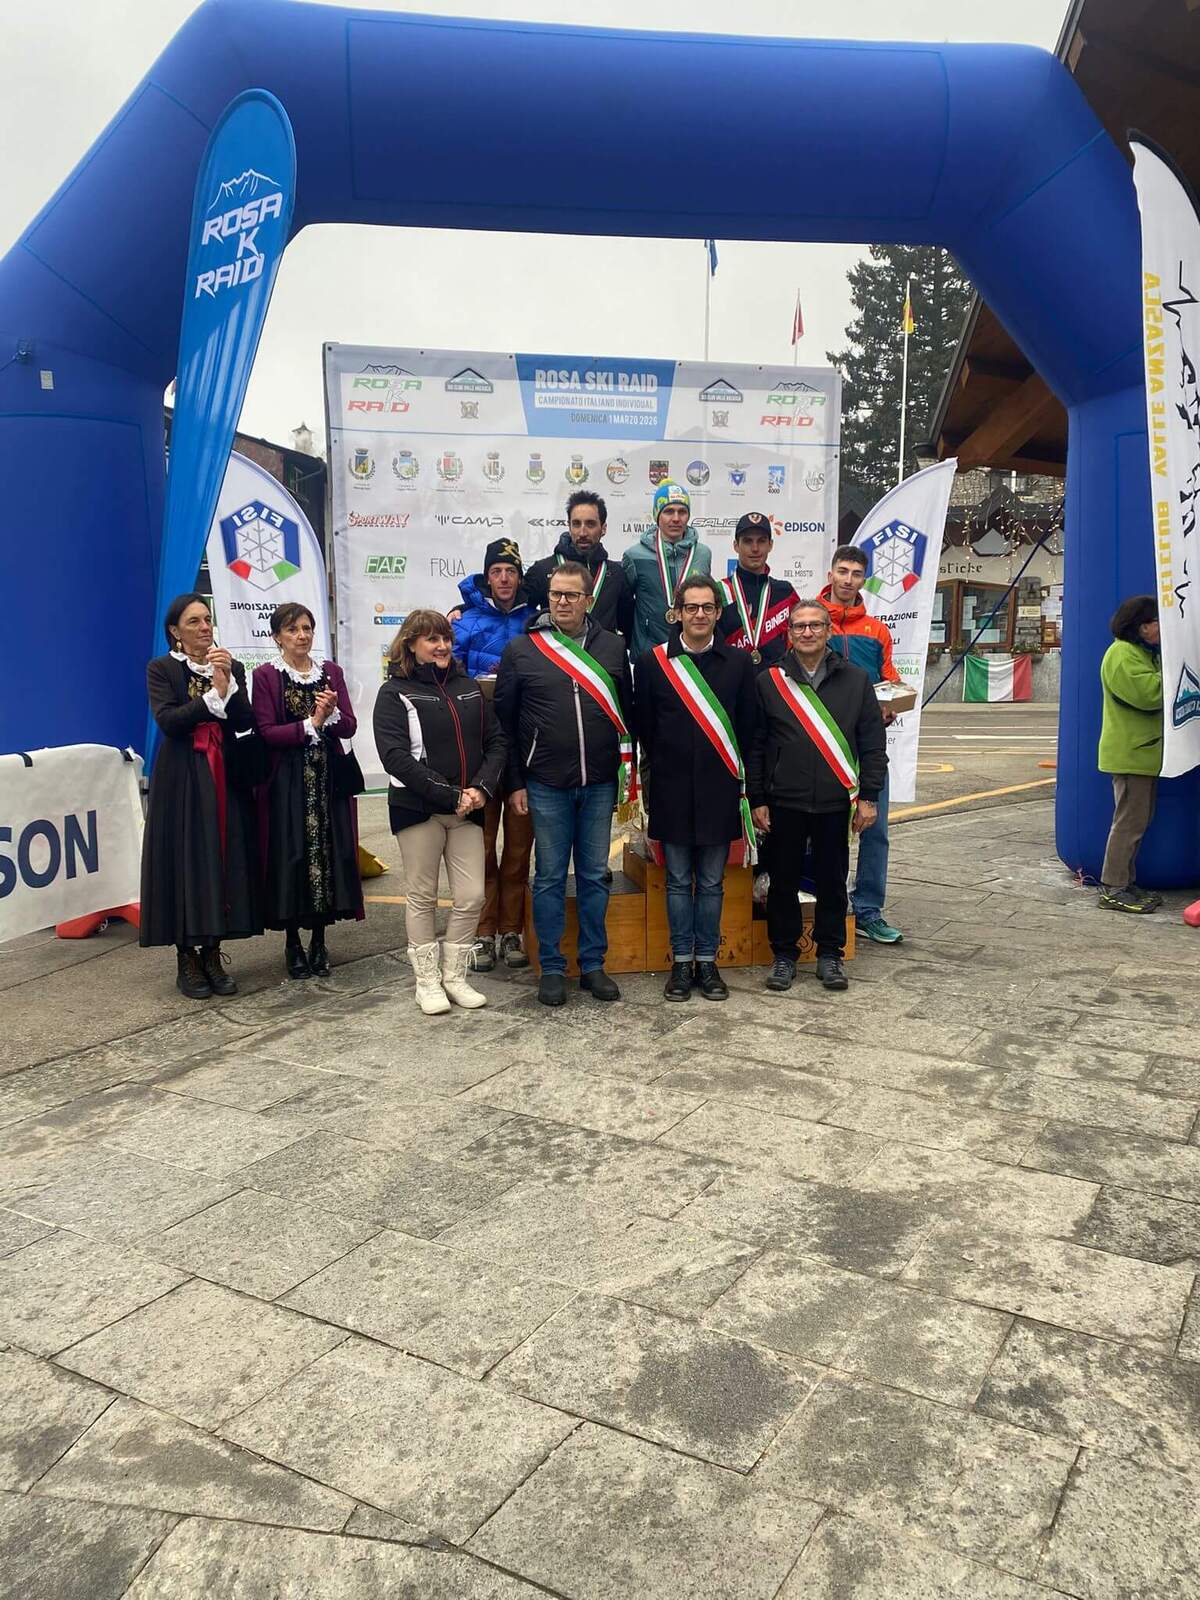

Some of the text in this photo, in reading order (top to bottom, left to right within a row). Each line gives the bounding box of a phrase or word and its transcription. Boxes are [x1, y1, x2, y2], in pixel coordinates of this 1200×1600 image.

[201, 192, 283, 246] ROSA
[237, 226, 260, 259] K
[195, 253, 265, 299] RAID
[535, 369, 658, 393] ROSA SKI RAID
[538, 395, 583, 406] CAMPIONATO
[584, 397, 615, 408] ITALIANO
[571, 412, 607, 424] DOMENICA
[613, 414, 637, 425] MARZO
[639, 415, 658, 426] 2026
[451, 516, 504, 528] CAMP
[622, 523, 632, 533] LA
[872, 525, 919, 546] FISI
[366, 555, 407, 573] FAR
[430, 557, 466, 577] FRUA
[794, 561, 802, 569] CA
